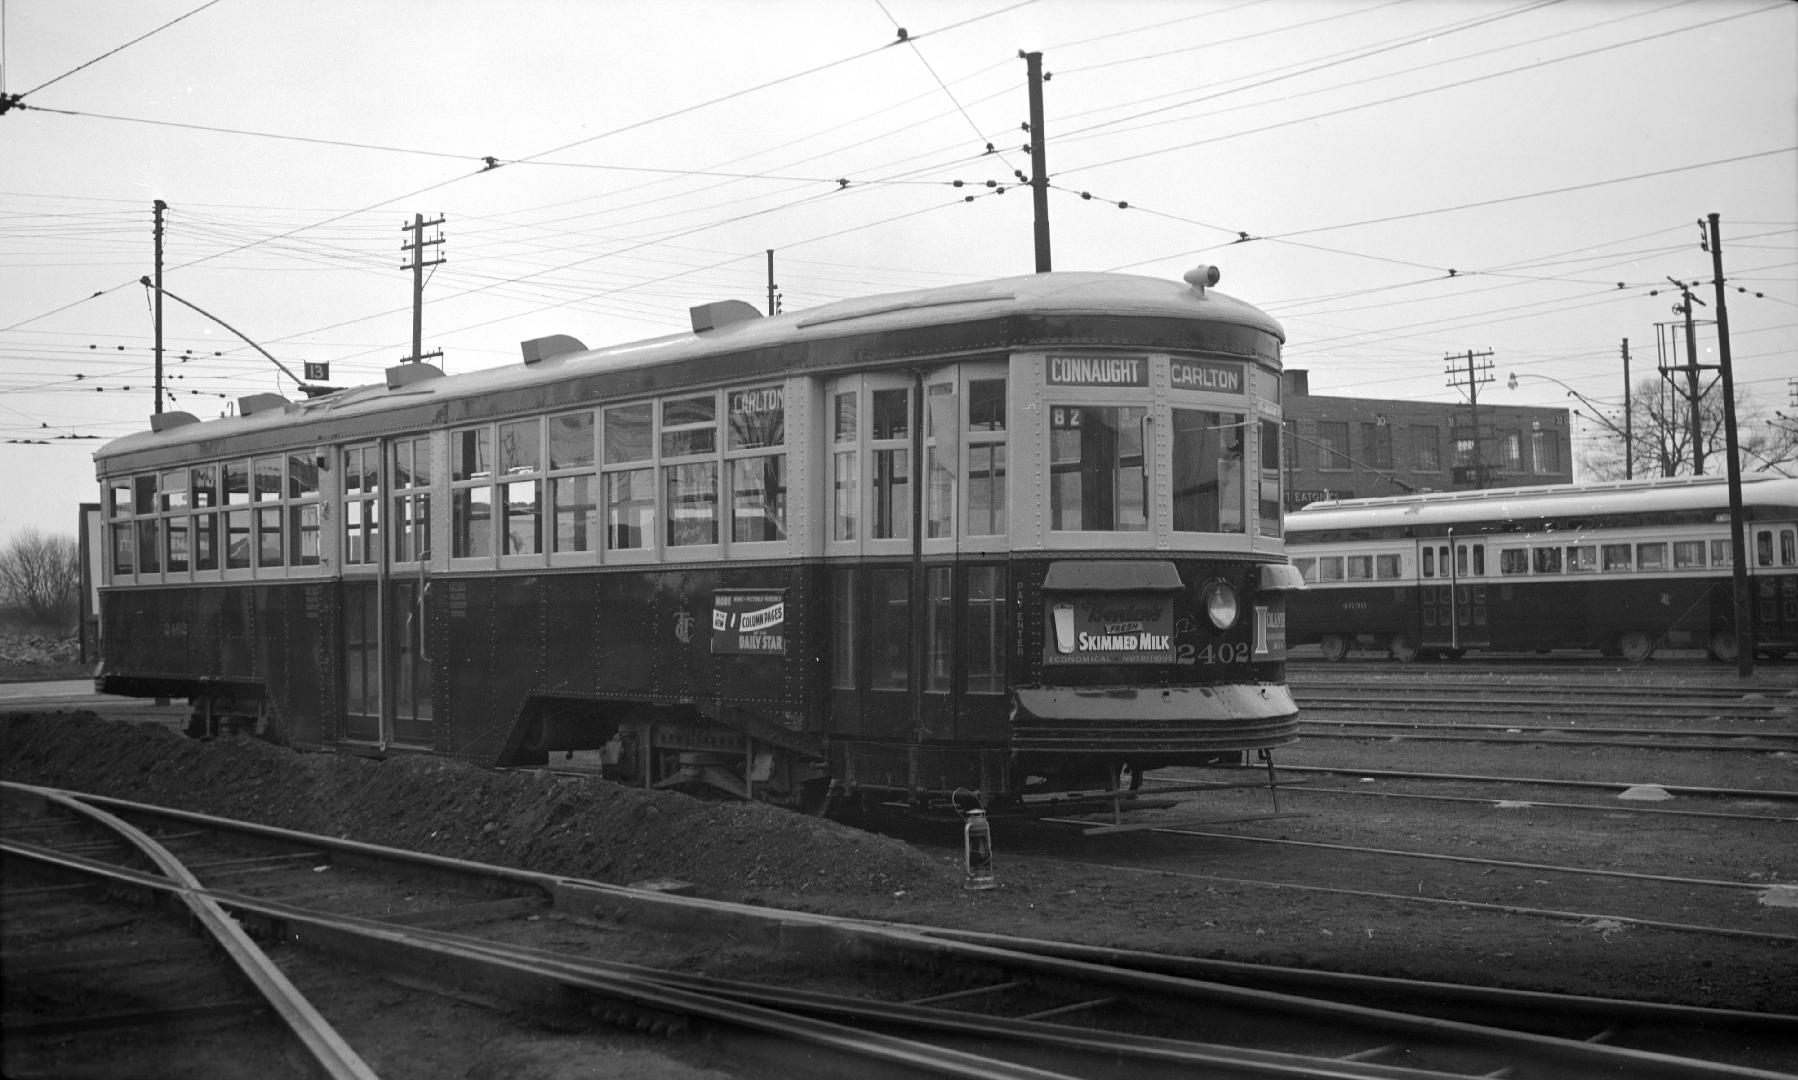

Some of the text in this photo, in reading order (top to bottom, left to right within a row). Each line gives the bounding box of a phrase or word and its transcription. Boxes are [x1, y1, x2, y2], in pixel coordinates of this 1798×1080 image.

[310, 364, 324, 379] 13
[1051, 357, 1139, 383] CONNAUGHT
[1170, 363, 1238, 390] CARLTON
[734, 387, 785, 414] CARLTON
[741, 613, 764, 629] COLUMN
[764, 607, 783, 625] PAGES
[1017, 581, 1025, 657] PAY ENTER
[1110, 622, 1139, 633] FRESH
[739, 635, 783, 650] DAILY STAR
[1078, 631, 1170, 651] SKIMMED MILK
[1048, 655, 1173, 664] ECONOMICAL NUTRITIOUS
[1177, 642, 1249, 665] 2402
